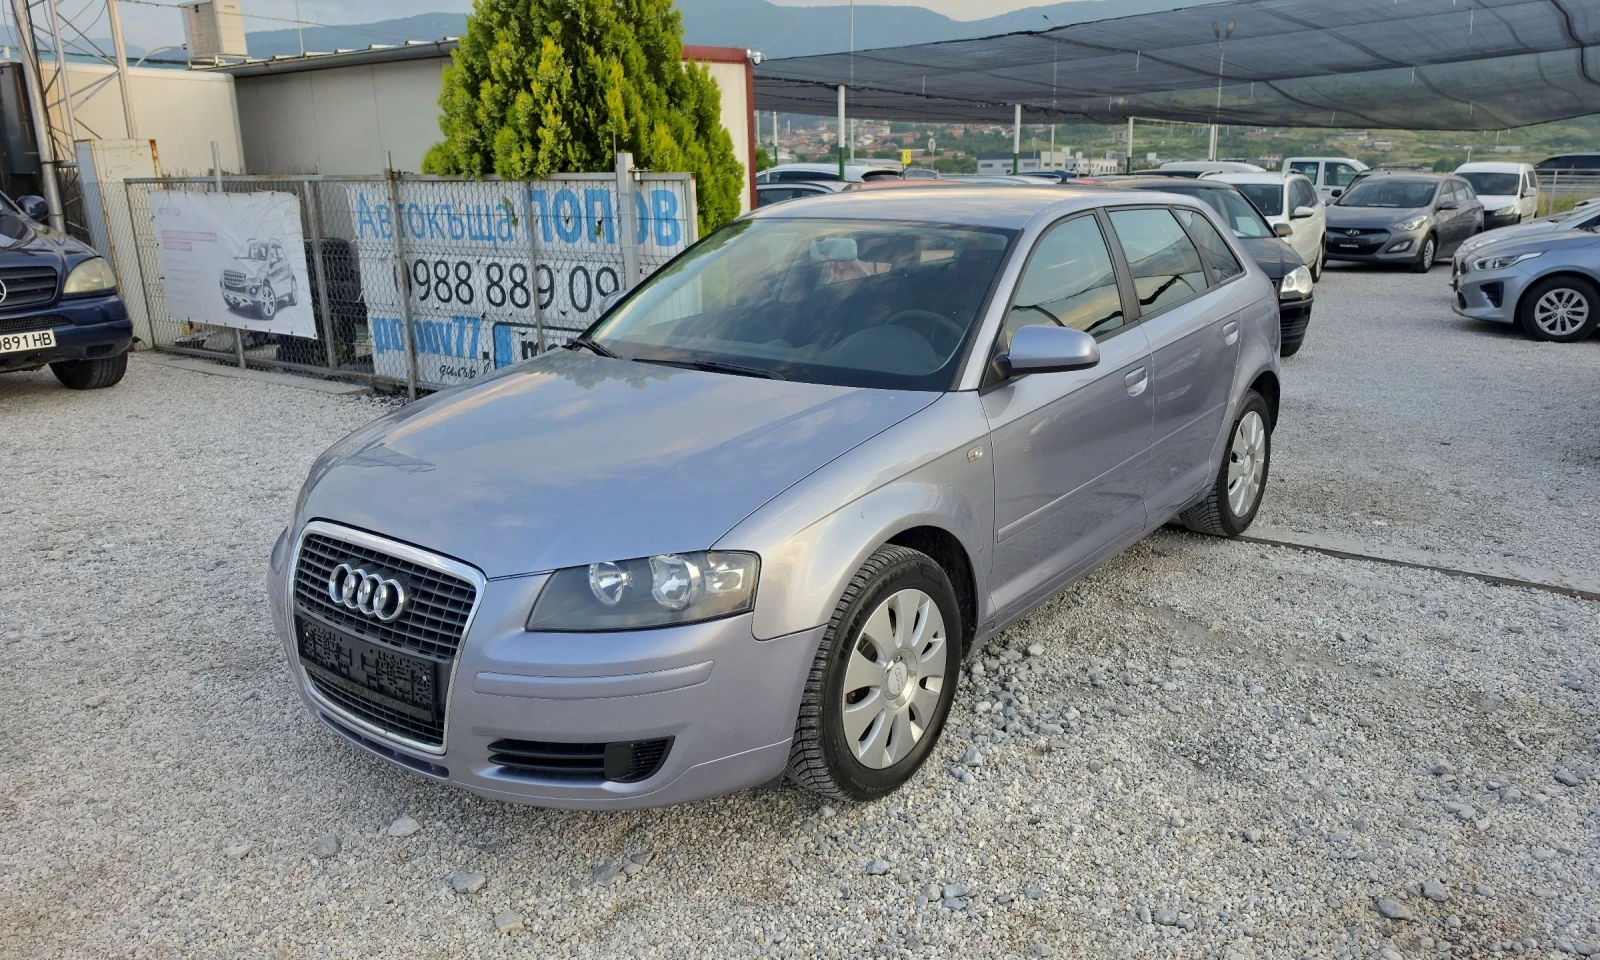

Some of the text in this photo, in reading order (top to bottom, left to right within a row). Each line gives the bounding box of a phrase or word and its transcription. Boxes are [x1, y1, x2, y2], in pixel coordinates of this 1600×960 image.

[358, 192, 515, 253] Автокъща
[393, 258, 474, 305] 0988
[486, 262, 554, 310] 889
[0, 336, 29, 350] 891
